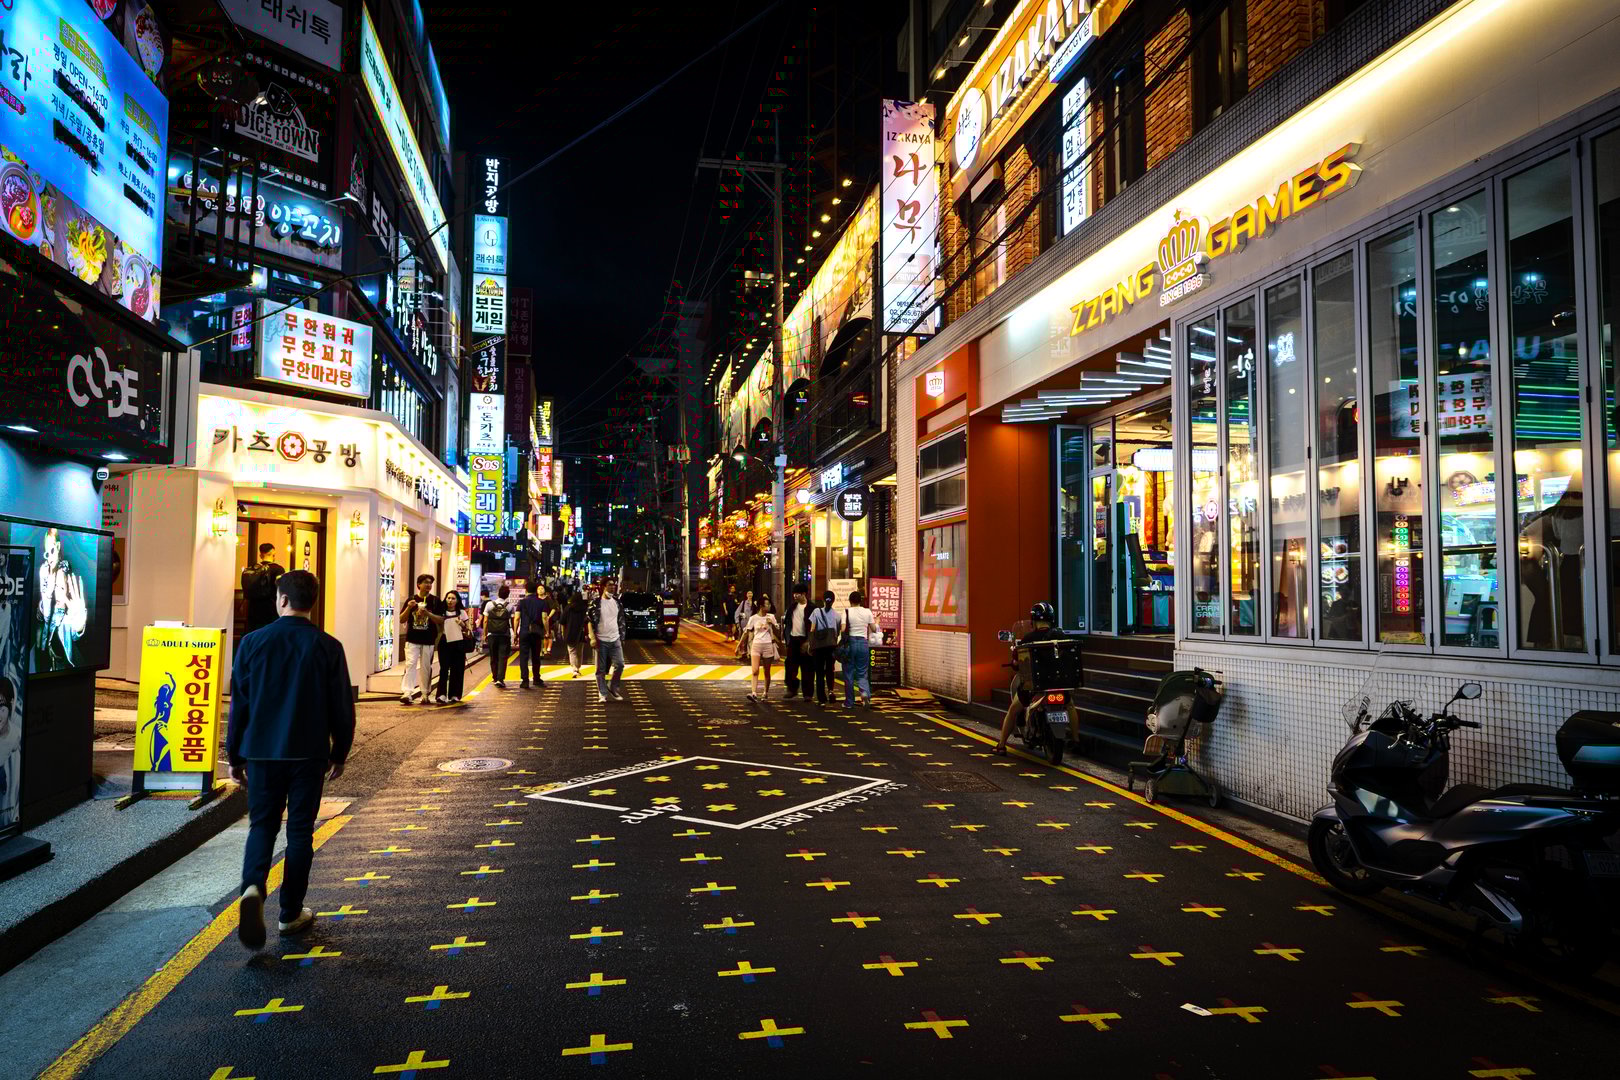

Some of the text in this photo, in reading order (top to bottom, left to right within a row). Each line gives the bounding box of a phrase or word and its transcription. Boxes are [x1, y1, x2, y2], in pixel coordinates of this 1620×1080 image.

[237, 102, 318, 153] DICE TOWN
[887, 131, 931, 145] IZAKAYA
[893, 152, 927, 244] 나무
[271, 203, 341, 245] 양꼬치
[1070, 142, 1358, 337] ZZANG GAMES
[476, 253, 505, 267] 래쉬톡
[1160, 273, 1203, 307] SINCE 1996
[475, 297, 504, 311] 보드
[475, 312, 504, 326] 게임
[281, 358, 352, 388] 무한마라탕
[475, 472, 498, 534] 노래방
[872, 586, 902, 599] 1억원
[872, 599, 901, 611] 1천명
[161, 640, 216, 649] ADULT SHOP
[180, 655, 213, 762] 성인용품
[750, 810, 815, 831] AREA
